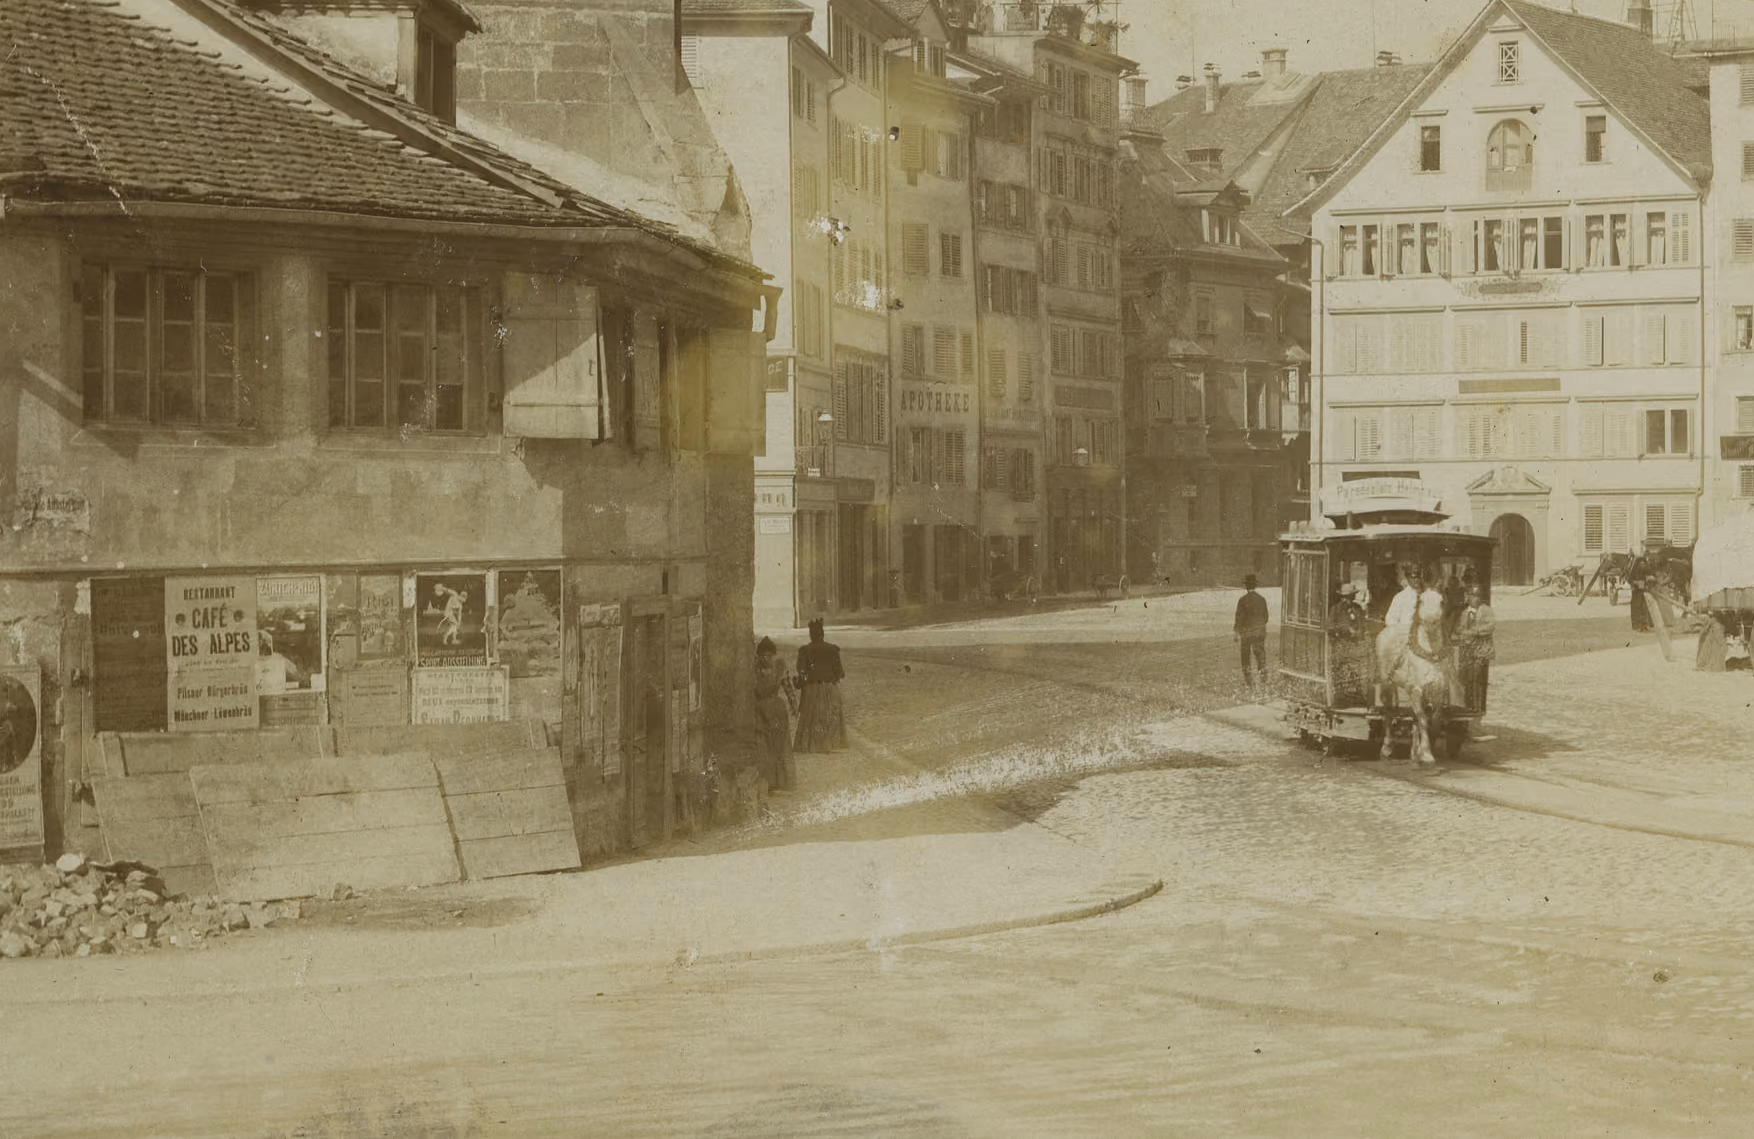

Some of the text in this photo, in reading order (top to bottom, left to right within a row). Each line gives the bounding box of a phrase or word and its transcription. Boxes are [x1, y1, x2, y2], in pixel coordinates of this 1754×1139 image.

[901, 390, 970, 412] APOTHEKE
[183, 586, 236, 600] RESTAURANT
[192, 602, 227, 629] CAFÉ
[172, 631, 250, 656] DES ALPES
[177, 686, 203, 700] Pilsner
